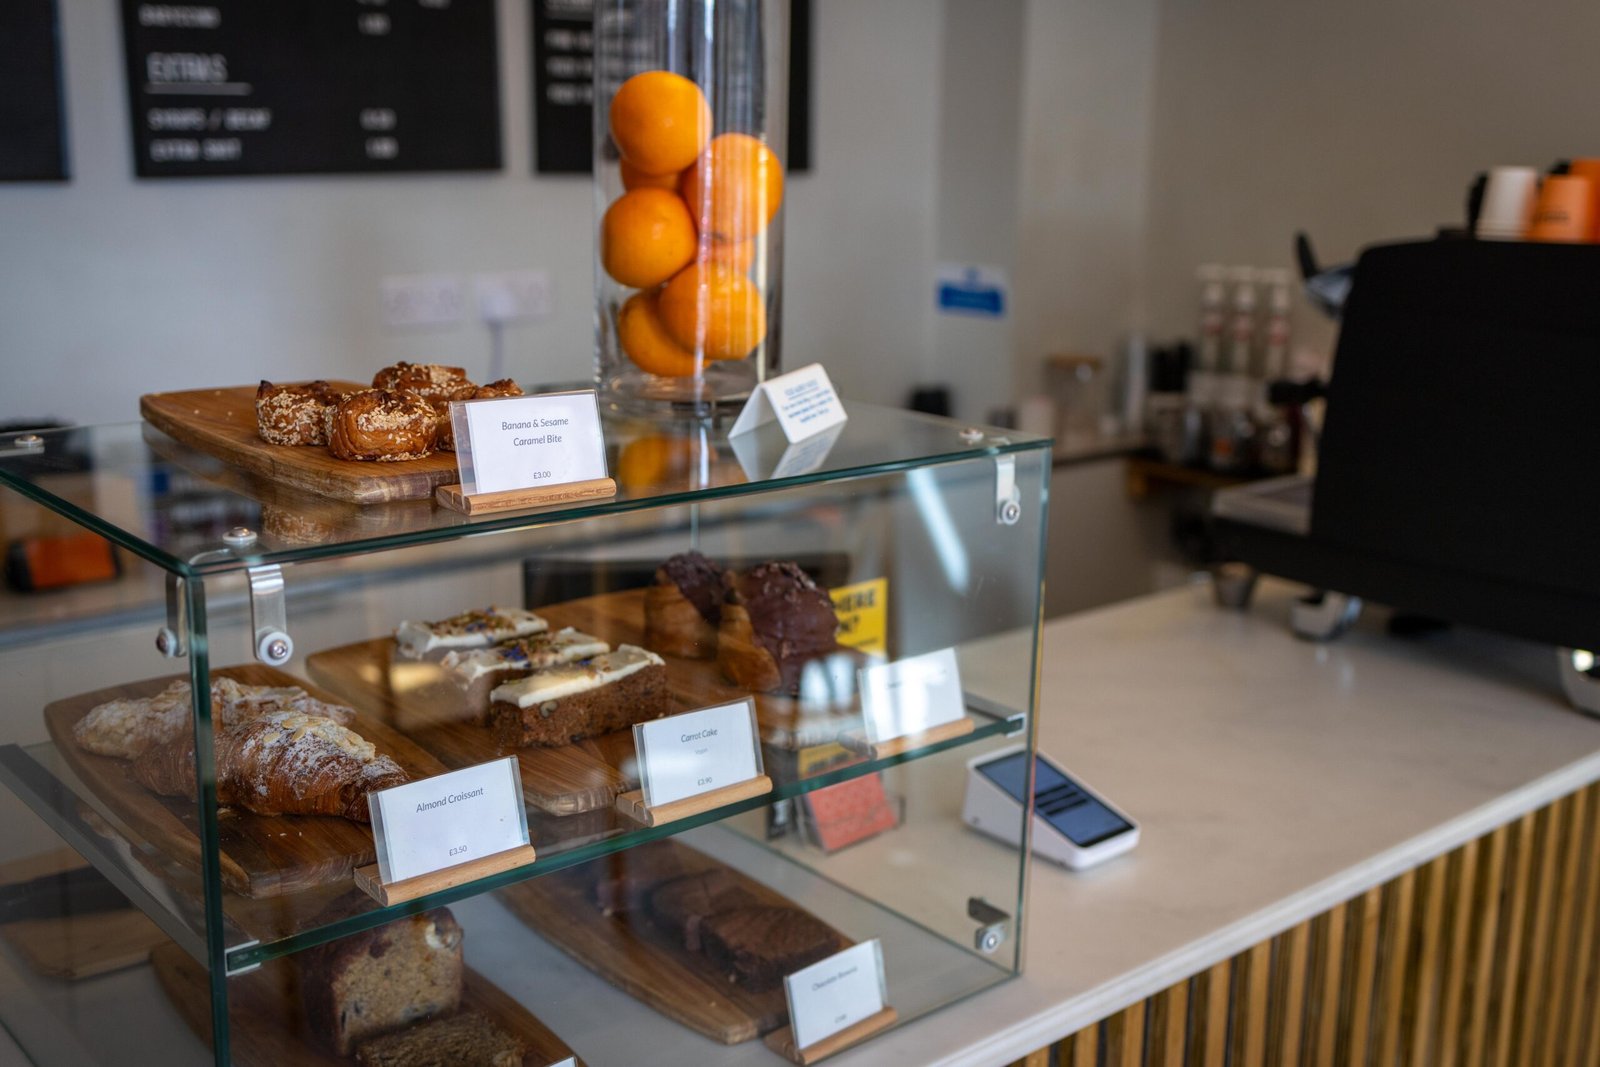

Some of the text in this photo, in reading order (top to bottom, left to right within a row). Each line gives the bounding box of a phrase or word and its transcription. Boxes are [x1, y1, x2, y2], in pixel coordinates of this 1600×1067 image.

[501, 418, 569, 431] Banana & Sesame
[513, 434, 562, 446] Caramel Bite
[533, 470, 552, 480] £3.00
[680, 728, 718, 743] Carrot Cake
[416, 787, 484, 813] Almond Croissant
[449, 844, 468, 857] £3.50
